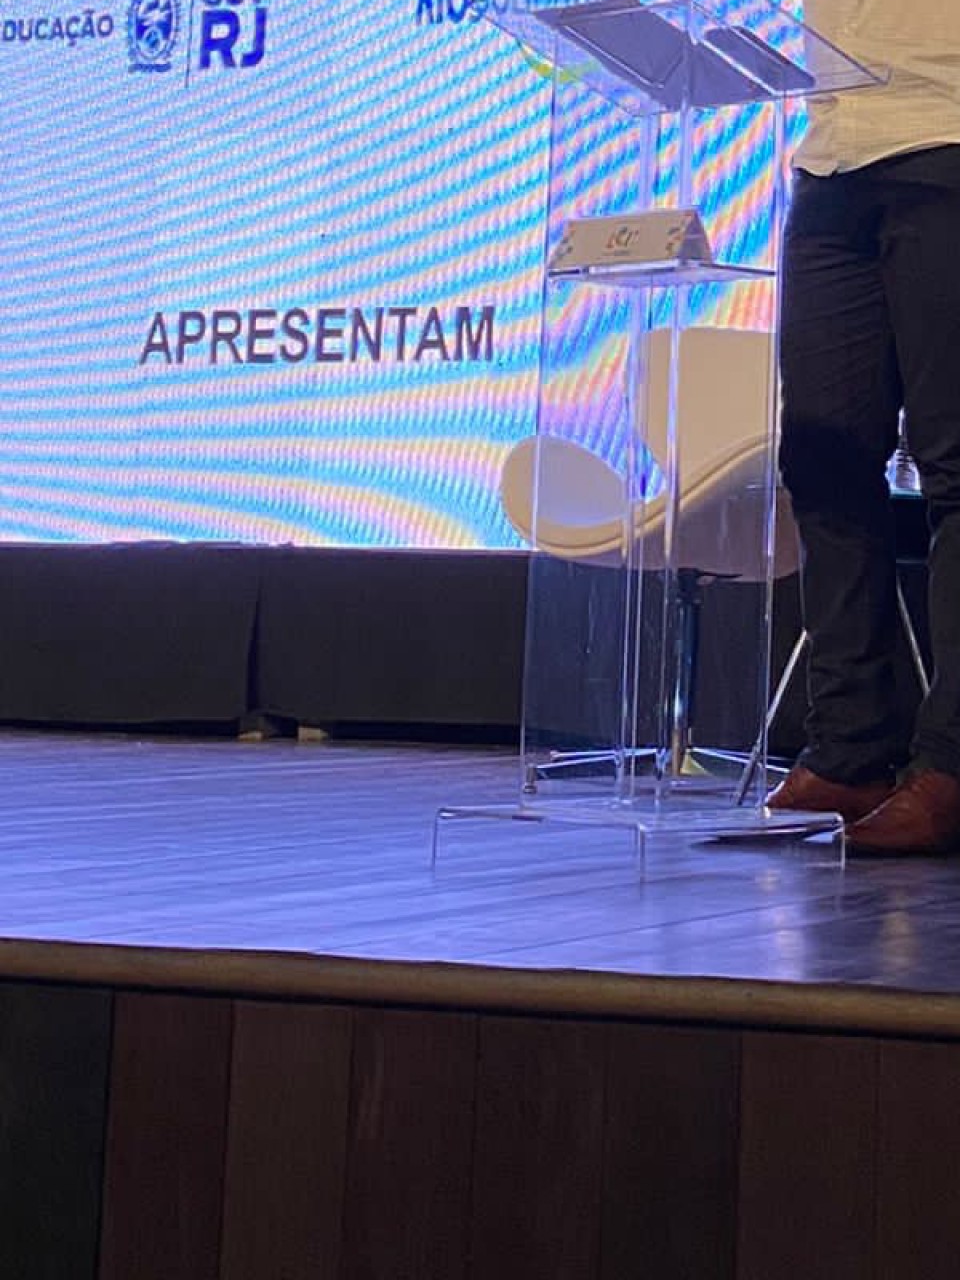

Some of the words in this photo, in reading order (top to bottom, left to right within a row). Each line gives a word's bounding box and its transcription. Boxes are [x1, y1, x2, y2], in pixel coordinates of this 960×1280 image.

[0, 8, 114, 47] DUCAÇÃO
[198, 7, 268, 69] RJ
[139, 305, 495, 365] APRESENTAM
